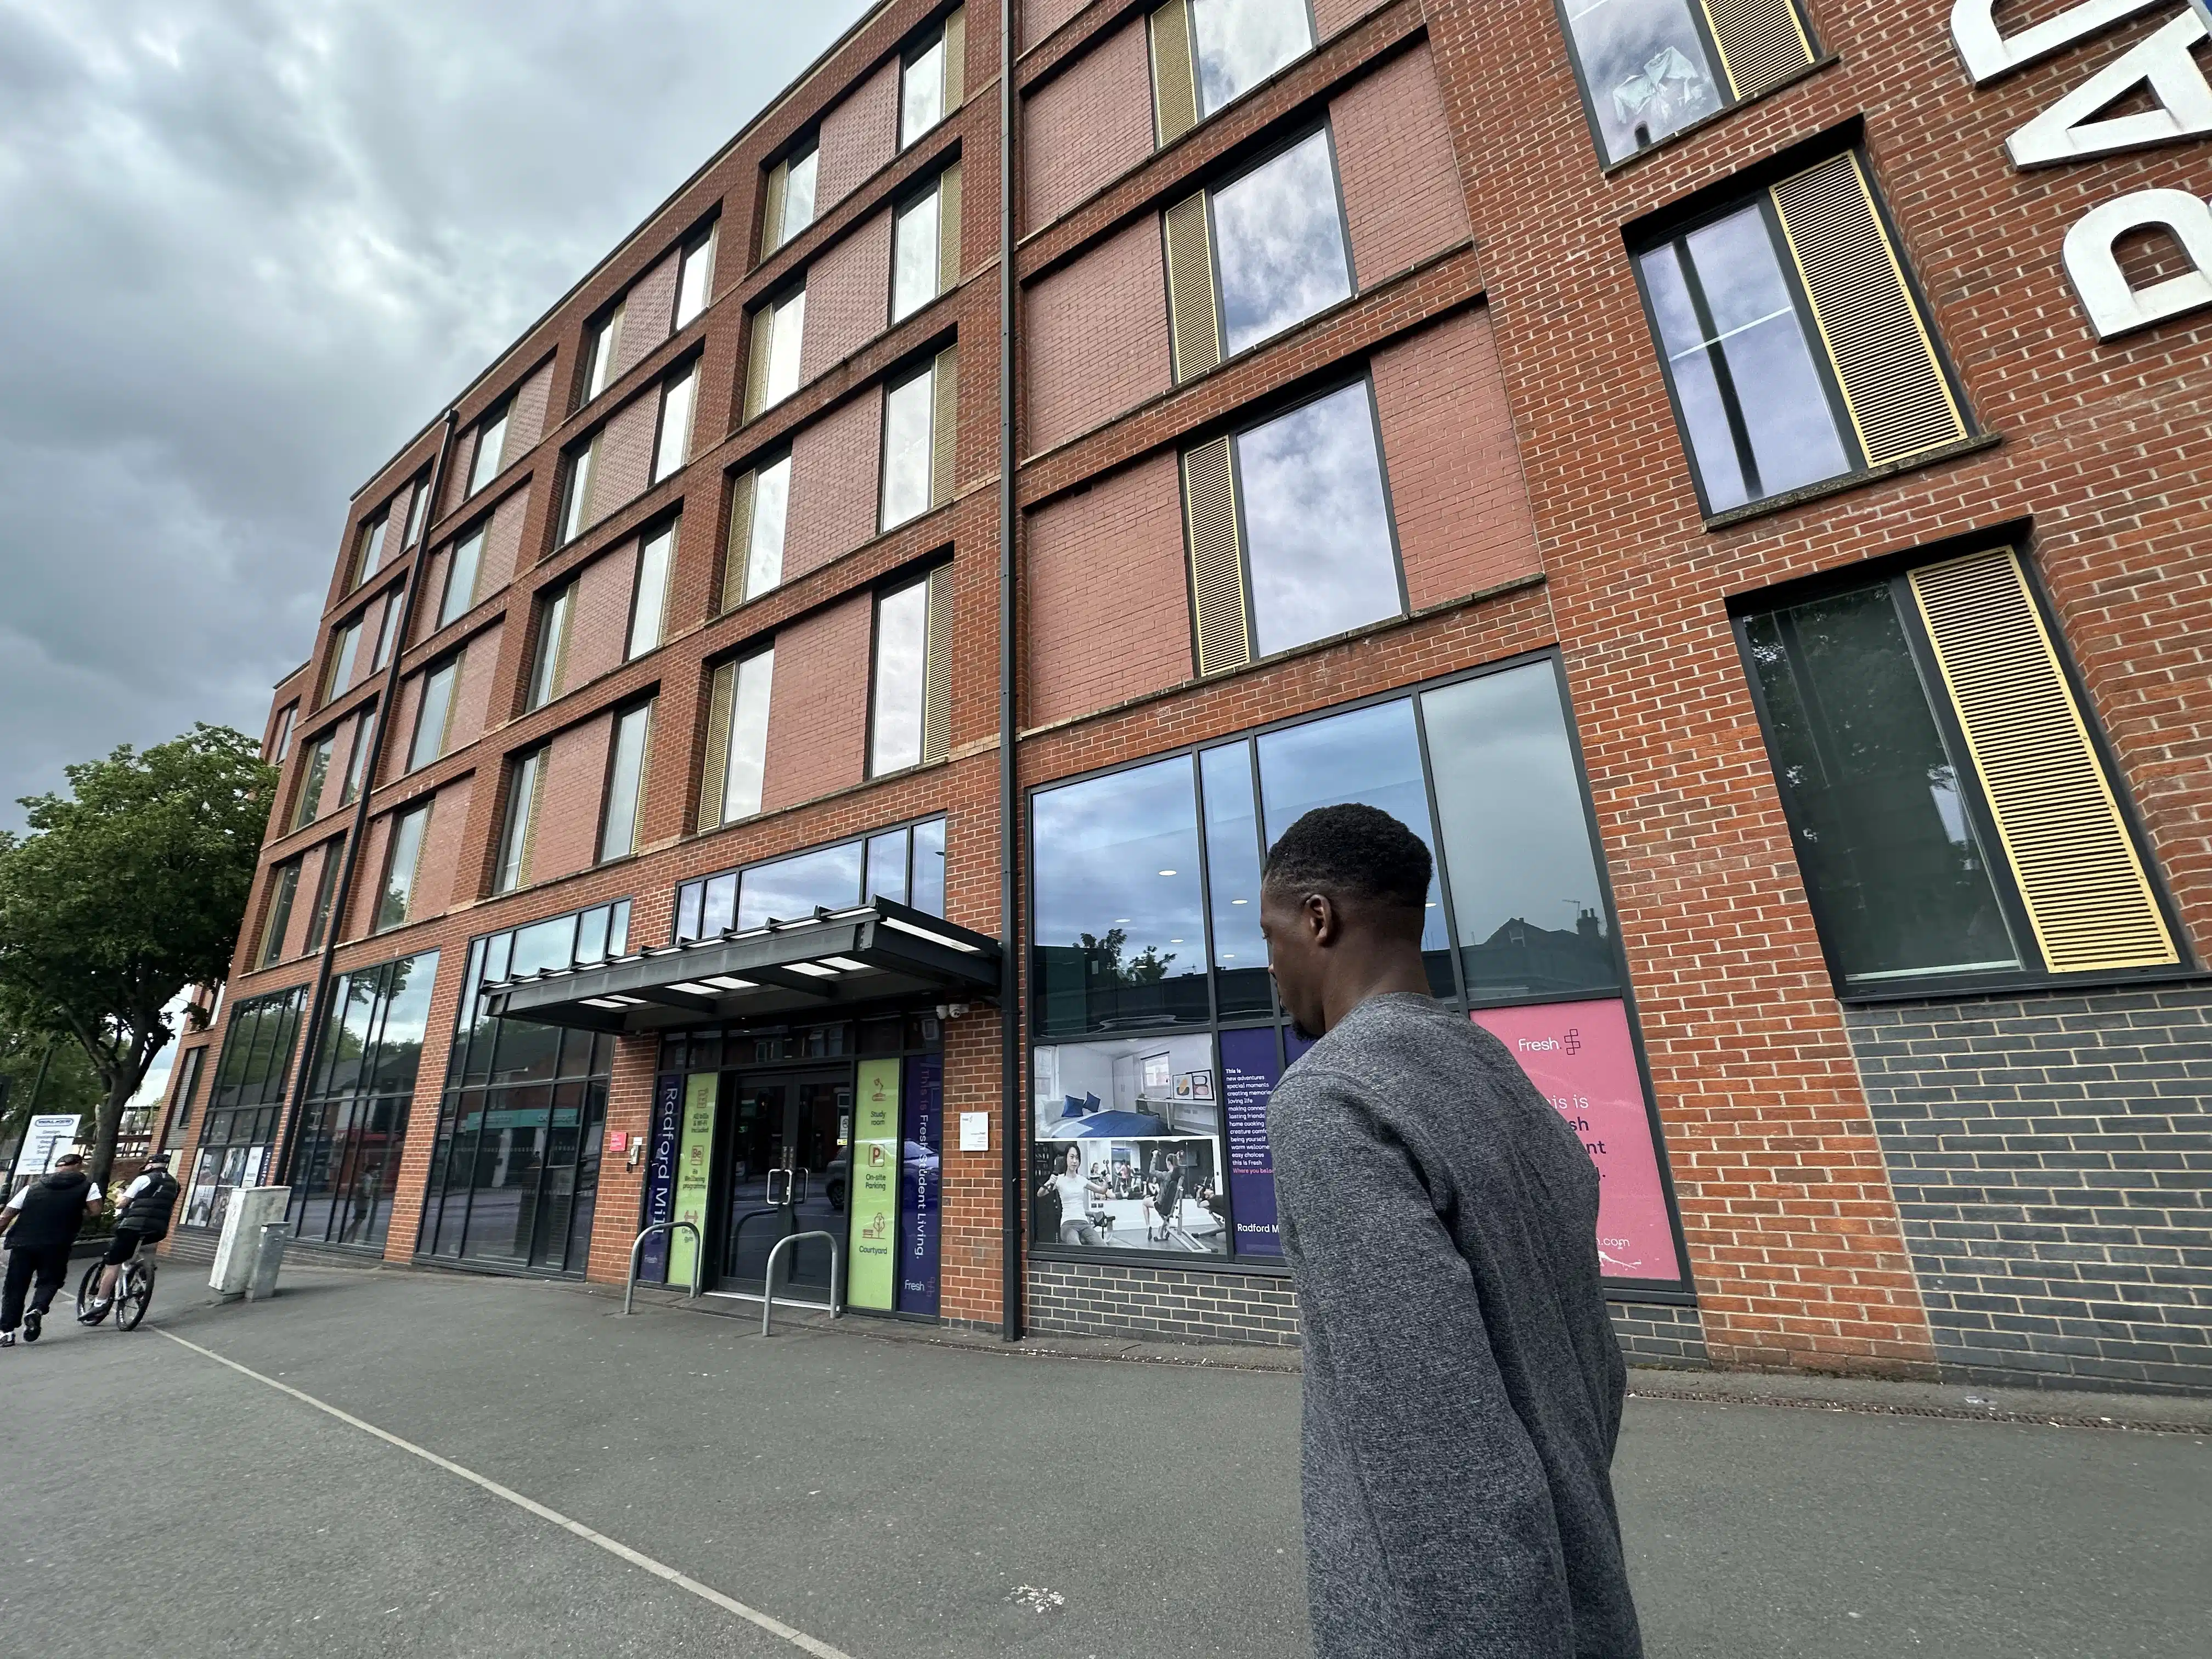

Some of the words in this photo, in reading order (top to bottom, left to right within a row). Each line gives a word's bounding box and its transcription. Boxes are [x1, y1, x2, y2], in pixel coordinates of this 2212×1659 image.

[1573, 1094, 1589, 1109] is
[871, 1110, 887, 1119] Study
[658, 1088, 678, 1178] Radford
[919, 1114, 928, 1150] Fresh
[692, 1148, 702, 1158] Be
[865, 1182, 886, 1190] Parking
[918, 1154, 928, 1209] Student
[652, 1188, 668, 1234] Mill
[1237, 1223, 1270, 1233] Radford
[915, 1213, 927, 1259] Living.
[859, 1245, 888, 1255] Courtyard
